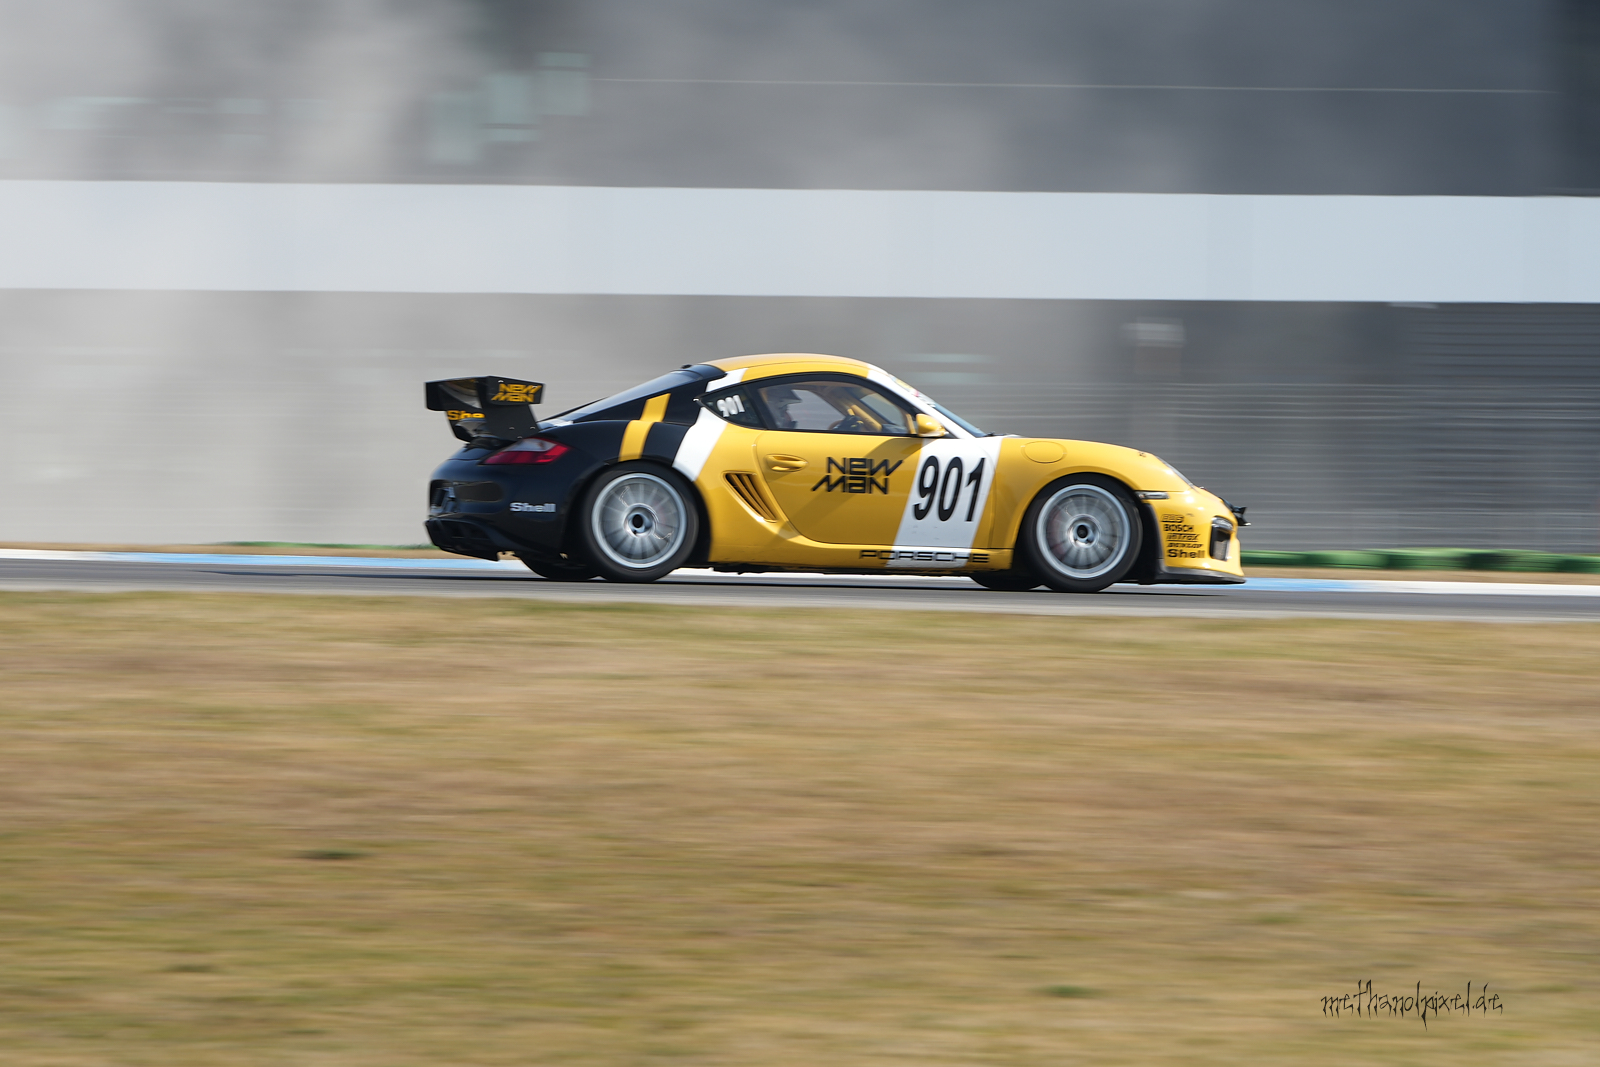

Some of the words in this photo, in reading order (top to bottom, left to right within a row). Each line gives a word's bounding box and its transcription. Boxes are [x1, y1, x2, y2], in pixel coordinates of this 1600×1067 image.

[716, 394, 745, 417] 901
[913, 455, 986, 522] 901
[510, 502, 556, 513] Shell
[1163, 524, 1194, 532] BOSCH
[859, 549, 990, 563] PORSCHE
[1167, 548, 1205, 558] Shell
